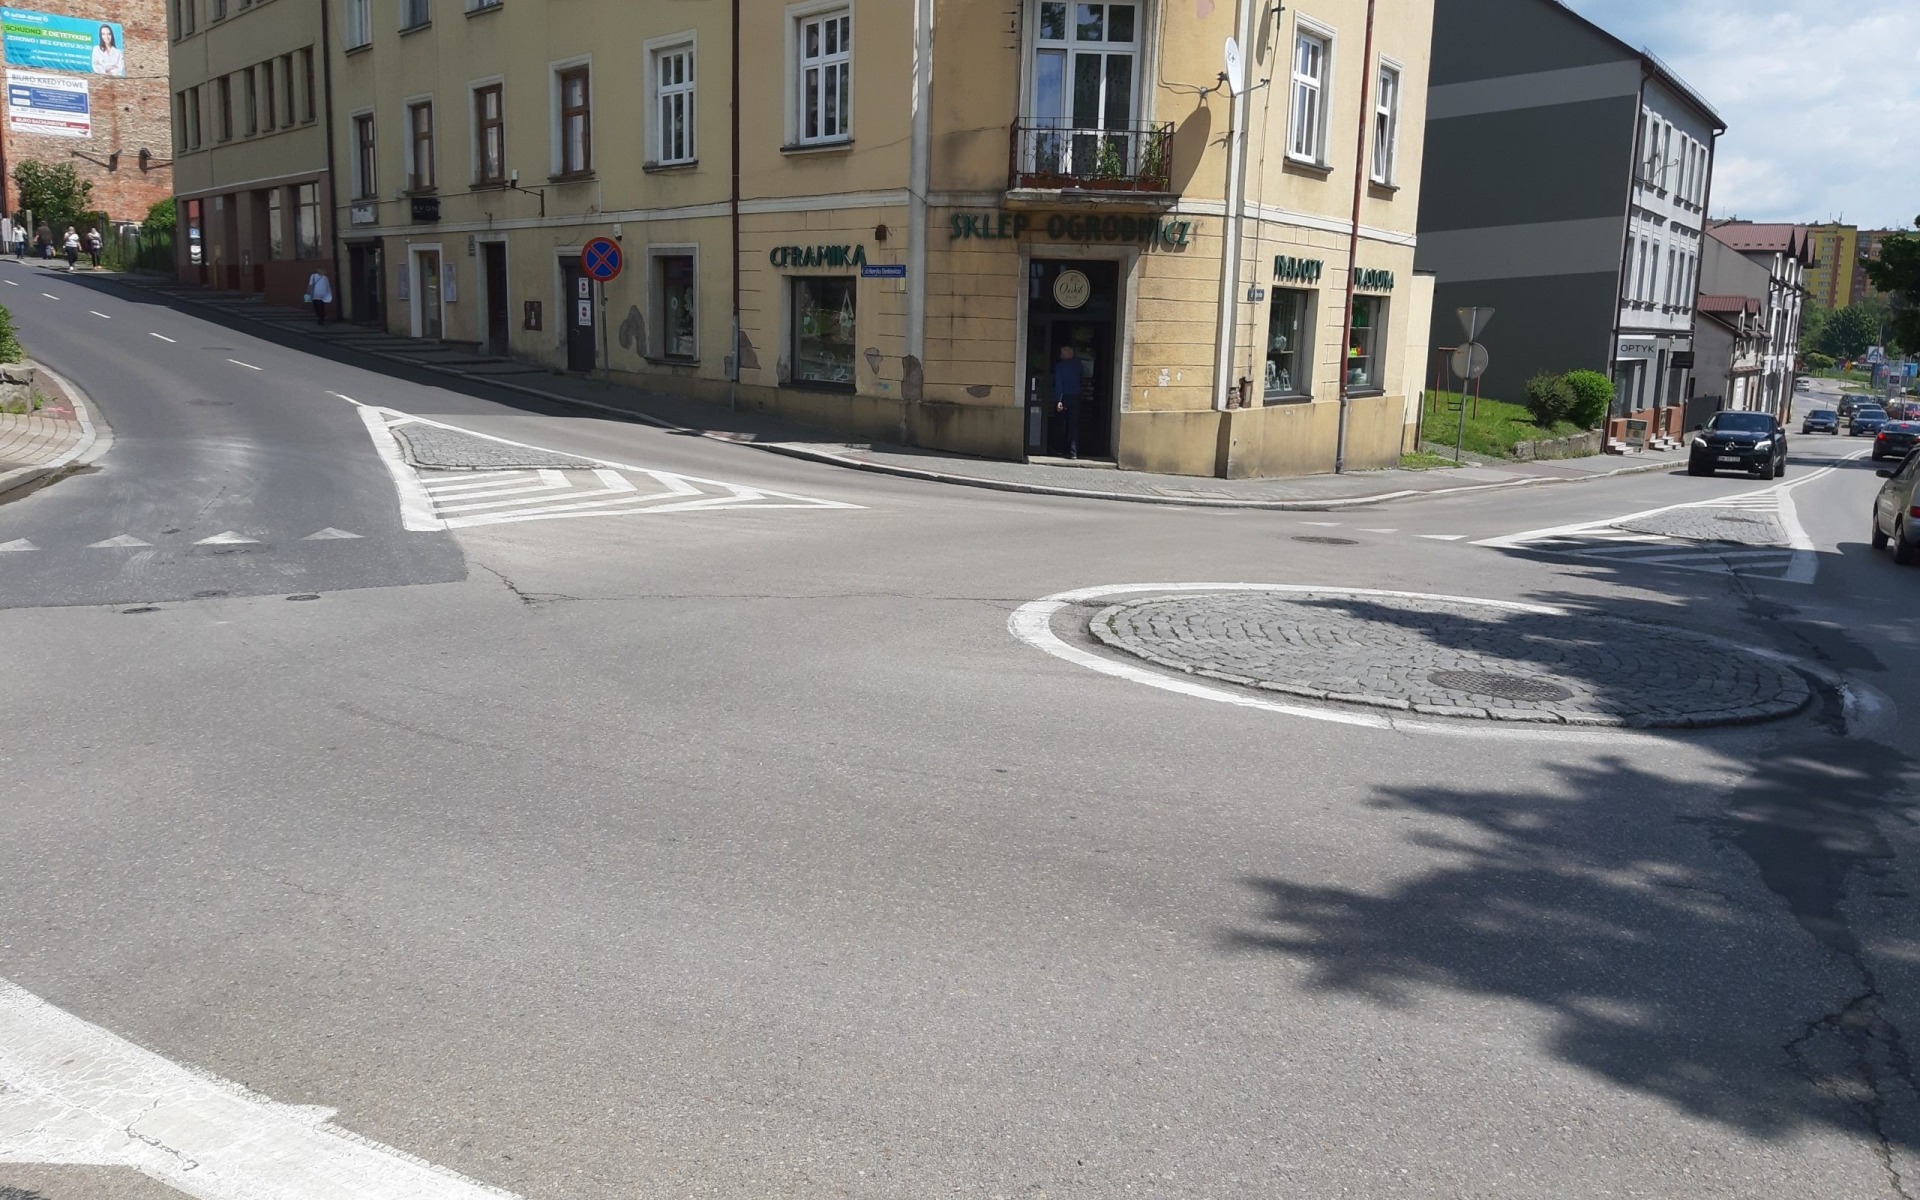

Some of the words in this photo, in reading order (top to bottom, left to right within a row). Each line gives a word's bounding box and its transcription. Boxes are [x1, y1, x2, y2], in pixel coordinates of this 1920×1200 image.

[48, 30, 92, 42] DIETETYKIEM
[11, 73, 36, 83] BIURO
[37, 77, 84, 89] KREDYTOWE
[951, 213, 1030, 240] SKLEP
[1274, 254, 1325, 280] NAWOZY
[1620, 344, 1656, 353] OPTYK
